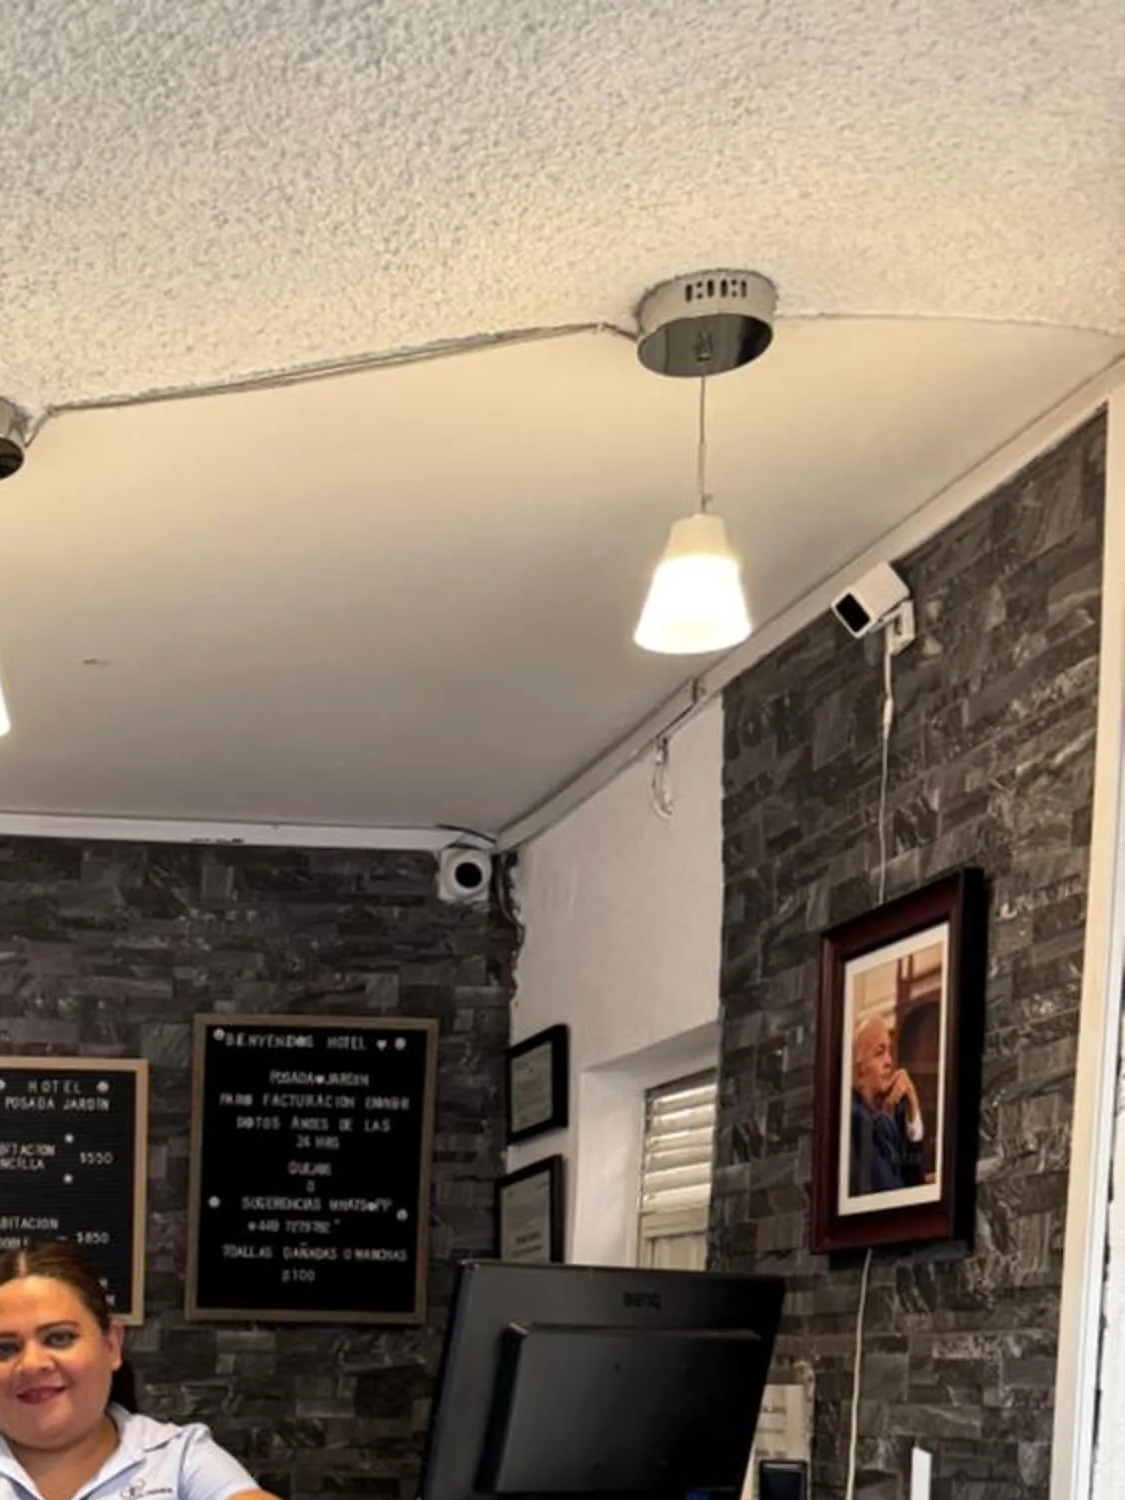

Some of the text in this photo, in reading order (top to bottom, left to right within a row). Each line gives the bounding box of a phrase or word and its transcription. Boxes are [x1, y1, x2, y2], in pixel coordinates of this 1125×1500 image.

[28, 1080, 81, 1094] HOTEL
[5, 1097, 55, 1111] POSADA
[364, 1118, 391, 1132] LAS
